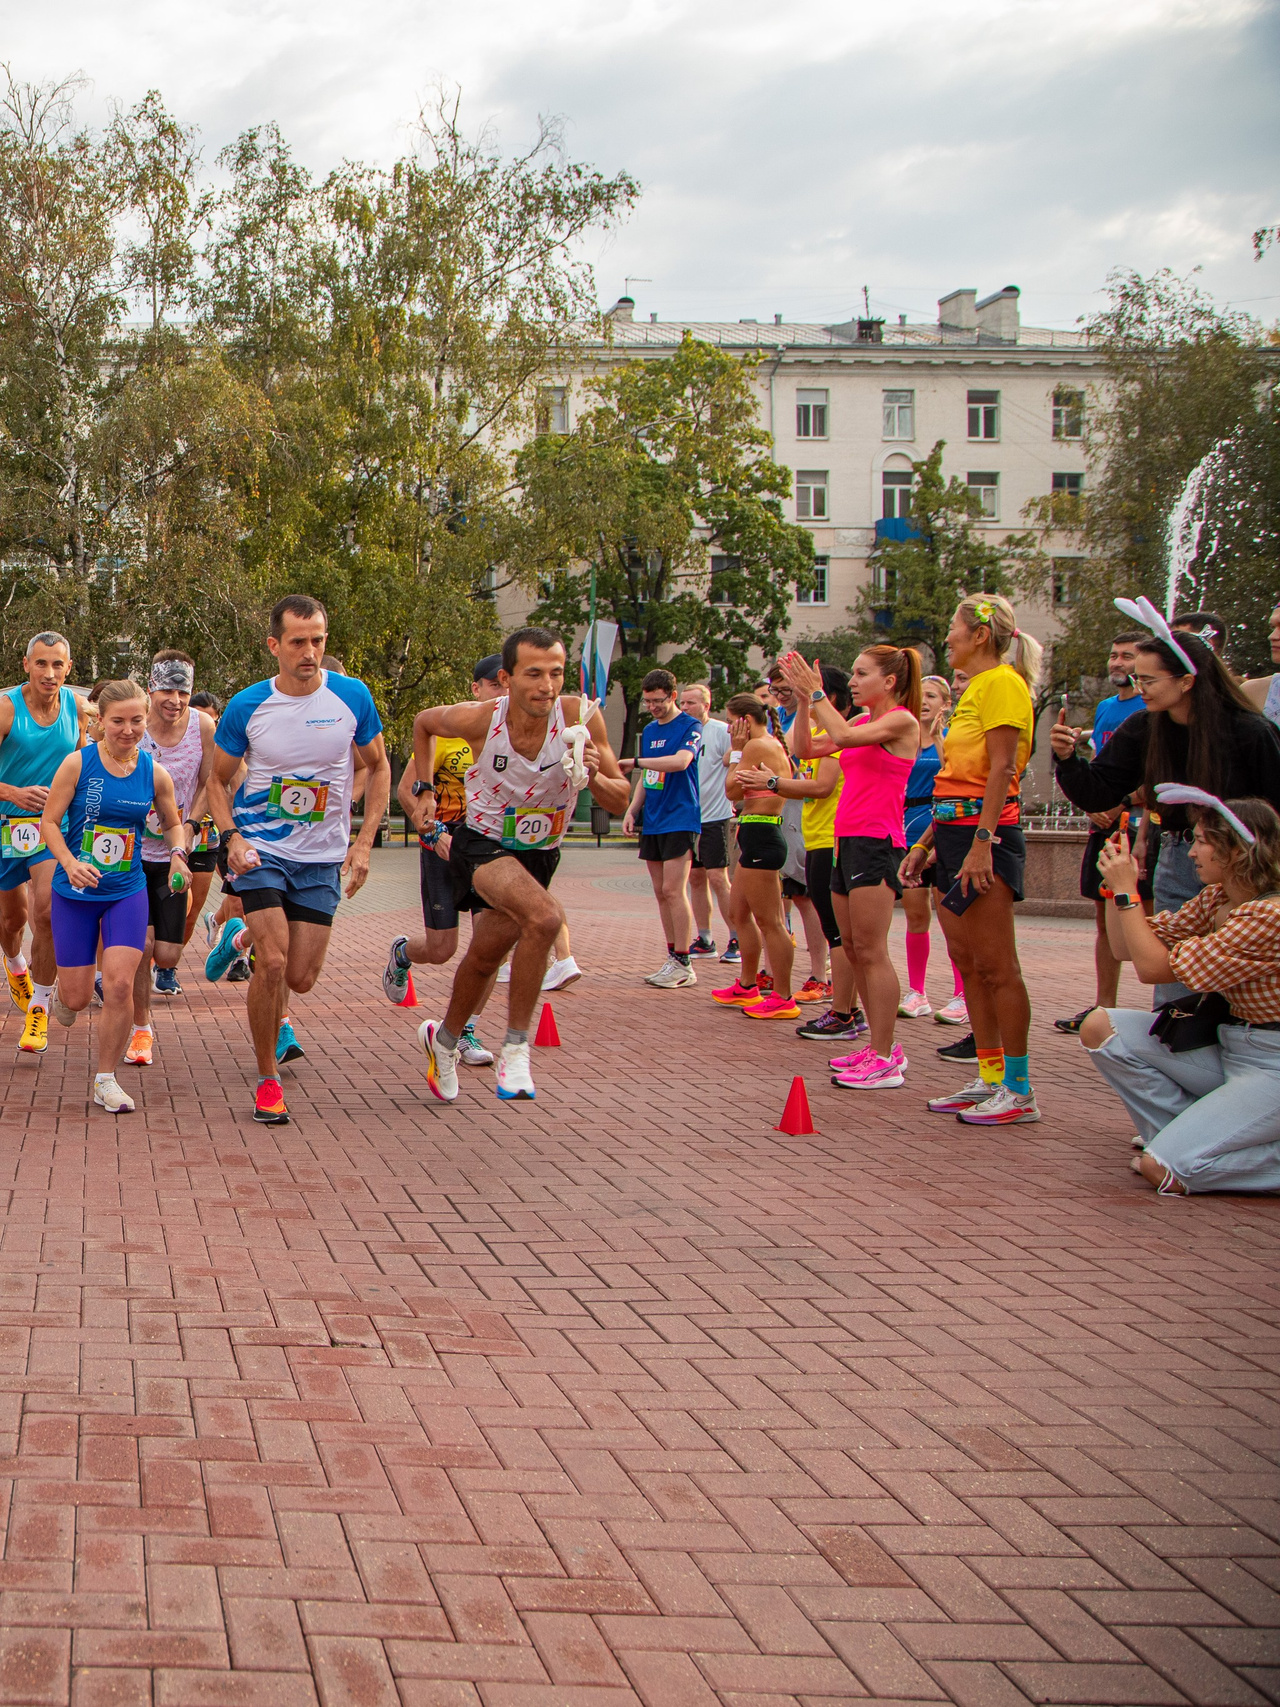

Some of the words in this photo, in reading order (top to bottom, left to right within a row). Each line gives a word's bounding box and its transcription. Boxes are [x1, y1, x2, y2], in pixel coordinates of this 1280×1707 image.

[450, 746, 470, 772] ЗОЛО
[290, 791, 301, 806] 2
[17, 828, 30, 842] 14
[520, 820, 542, 835] 20
[101, 838, 112, 854] 3
